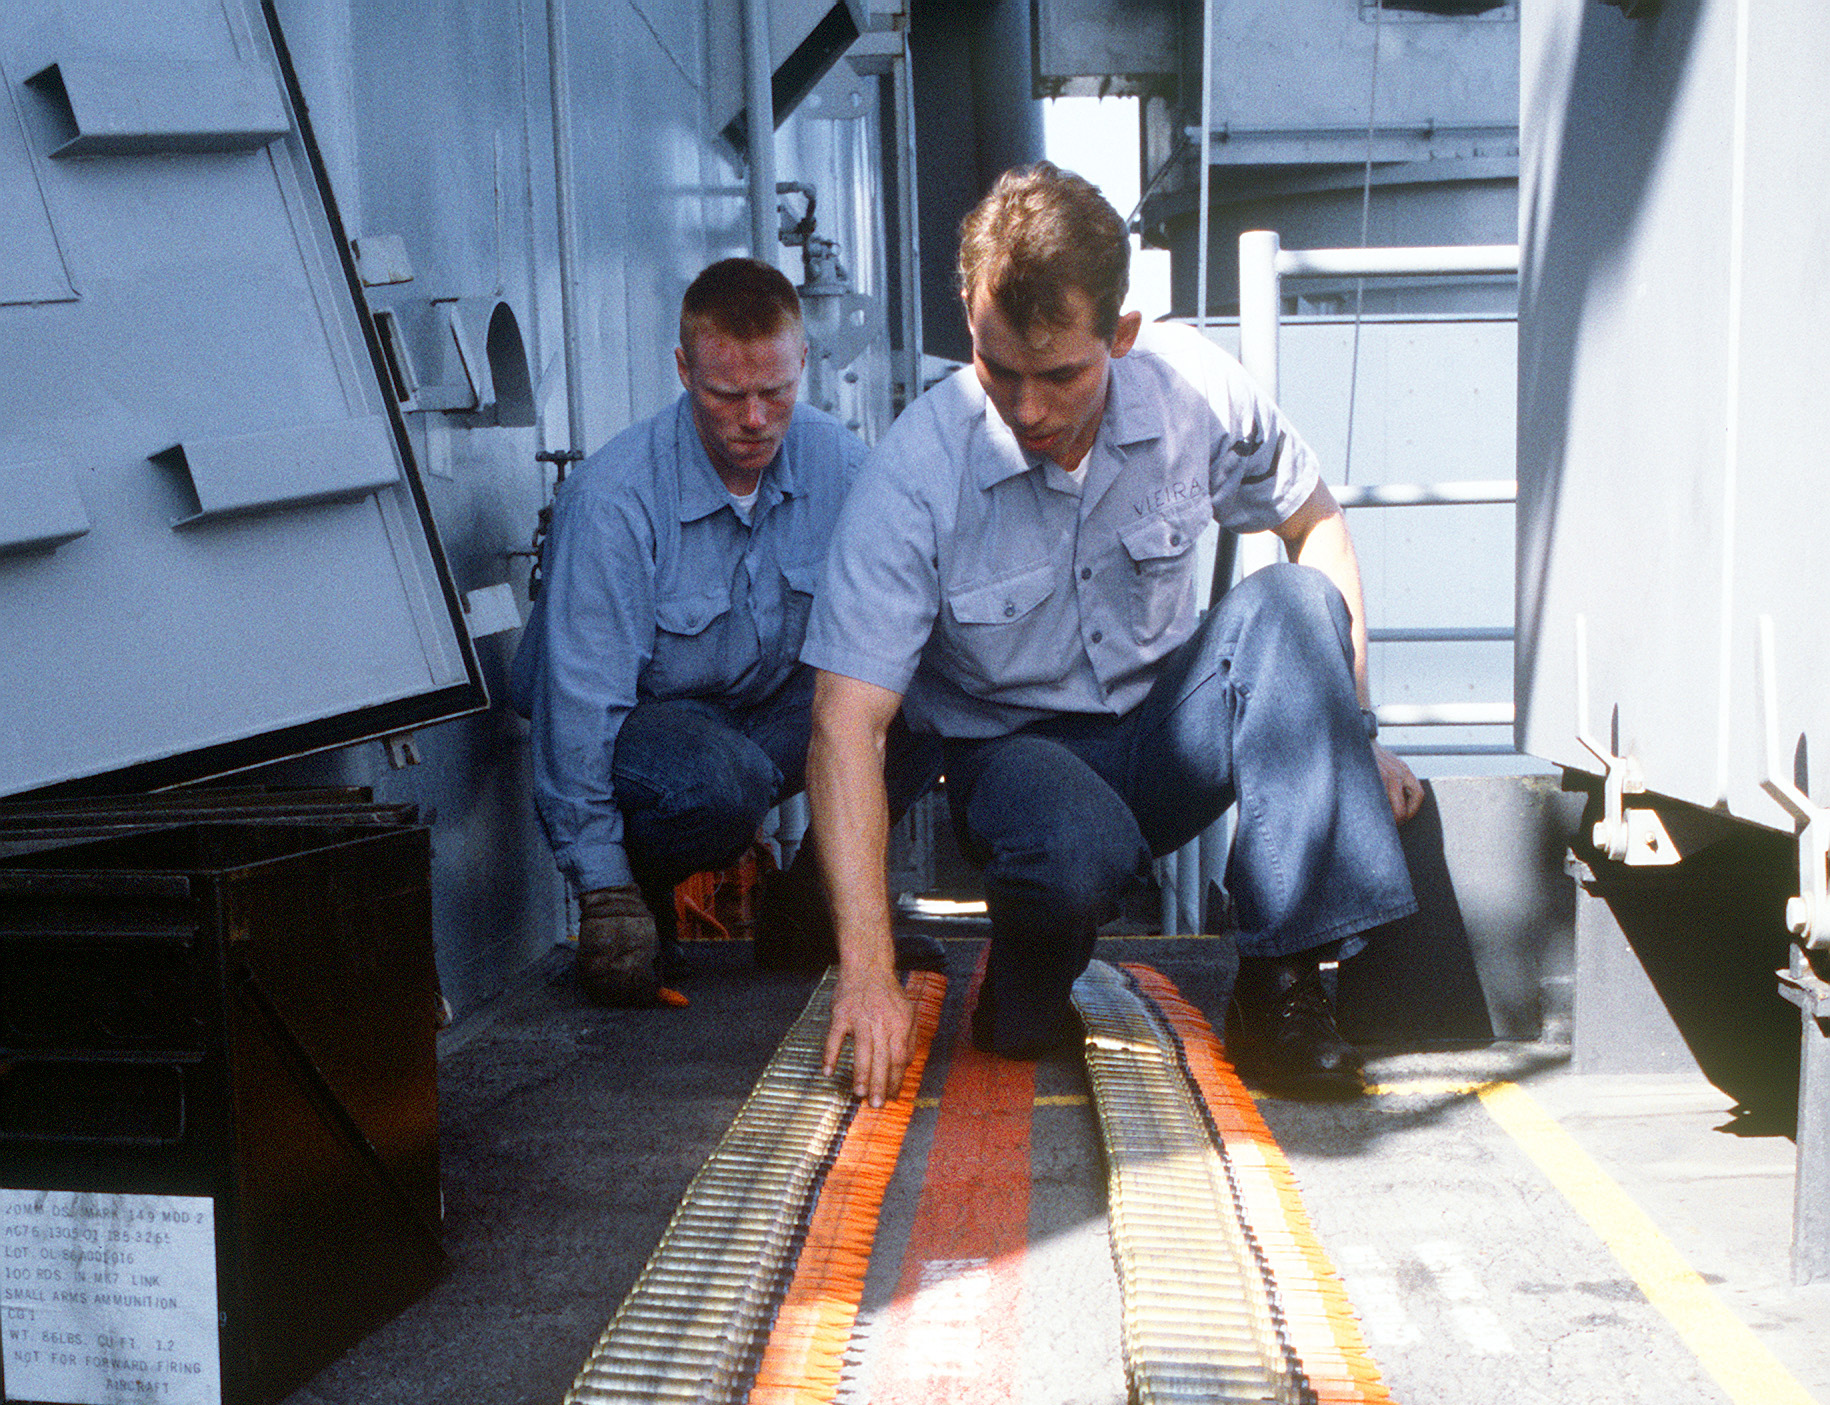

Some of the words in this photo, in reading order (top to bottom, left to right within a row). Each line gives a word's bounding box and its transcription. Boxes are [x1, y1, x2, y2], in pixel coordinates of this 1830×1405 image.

[1132, 477, 1201, 515] VIEIRA
[162, 1211, 190, 1224] MOD
[196, 1212, 204, 1224] 2
[5, 1267, 31, 1280] 100
[131, 1274, 160, 1287] LINK
[5, 1288, 46, 1301] SMALL
[53, 1291, 88, 1304] ARMS
[93, 1294, 177, 1310] AMMUNITION
[14, 1350, 40, 1364] NOT
[51, 1352, 77, 1366] FOR
[85, 1355, 149, 1372] FORWARD
[157, 1361, 202, 1374] FIRING
[105, 1378, 169, 1394] AIRCRAFT
